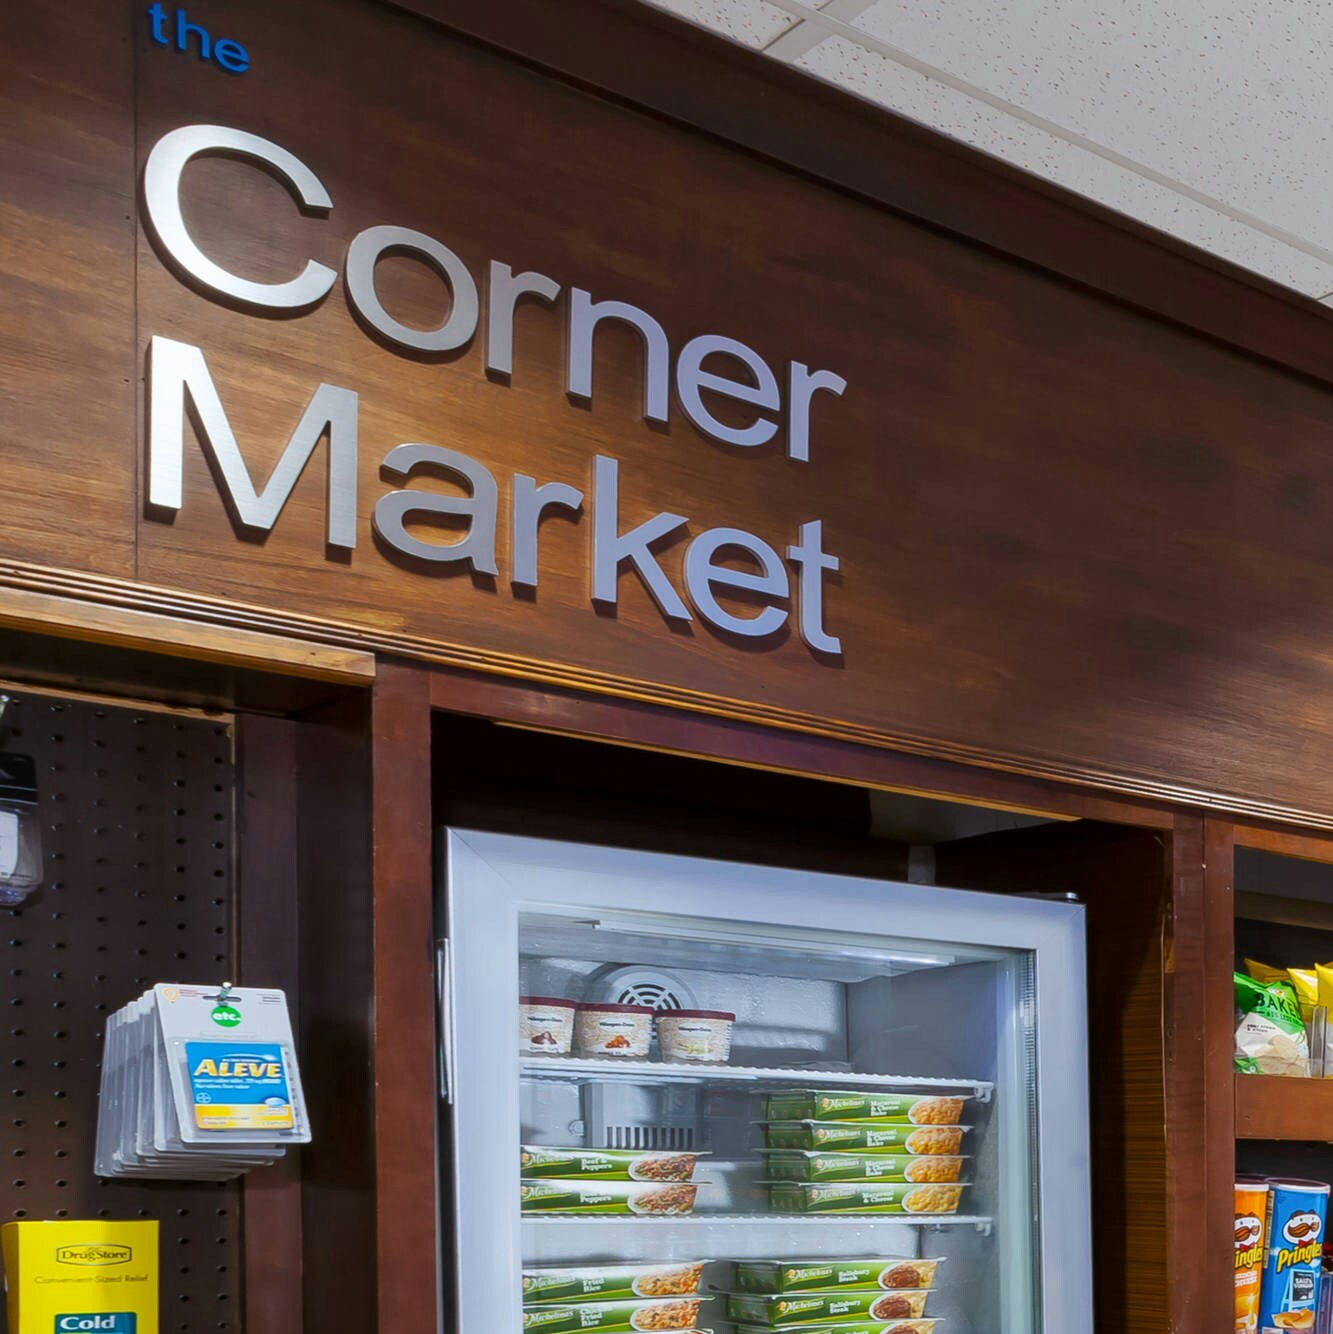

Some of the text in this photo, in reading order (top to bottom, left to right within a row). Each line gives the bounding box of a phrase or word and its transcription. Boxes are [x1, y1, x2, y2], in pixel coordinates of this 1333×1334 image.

[148, 2, 250, 74] the
[144, 125, 847, 462] Corner
[148, 335, 843, 655] Market
[60, 1316, 115, 1330] Cold
